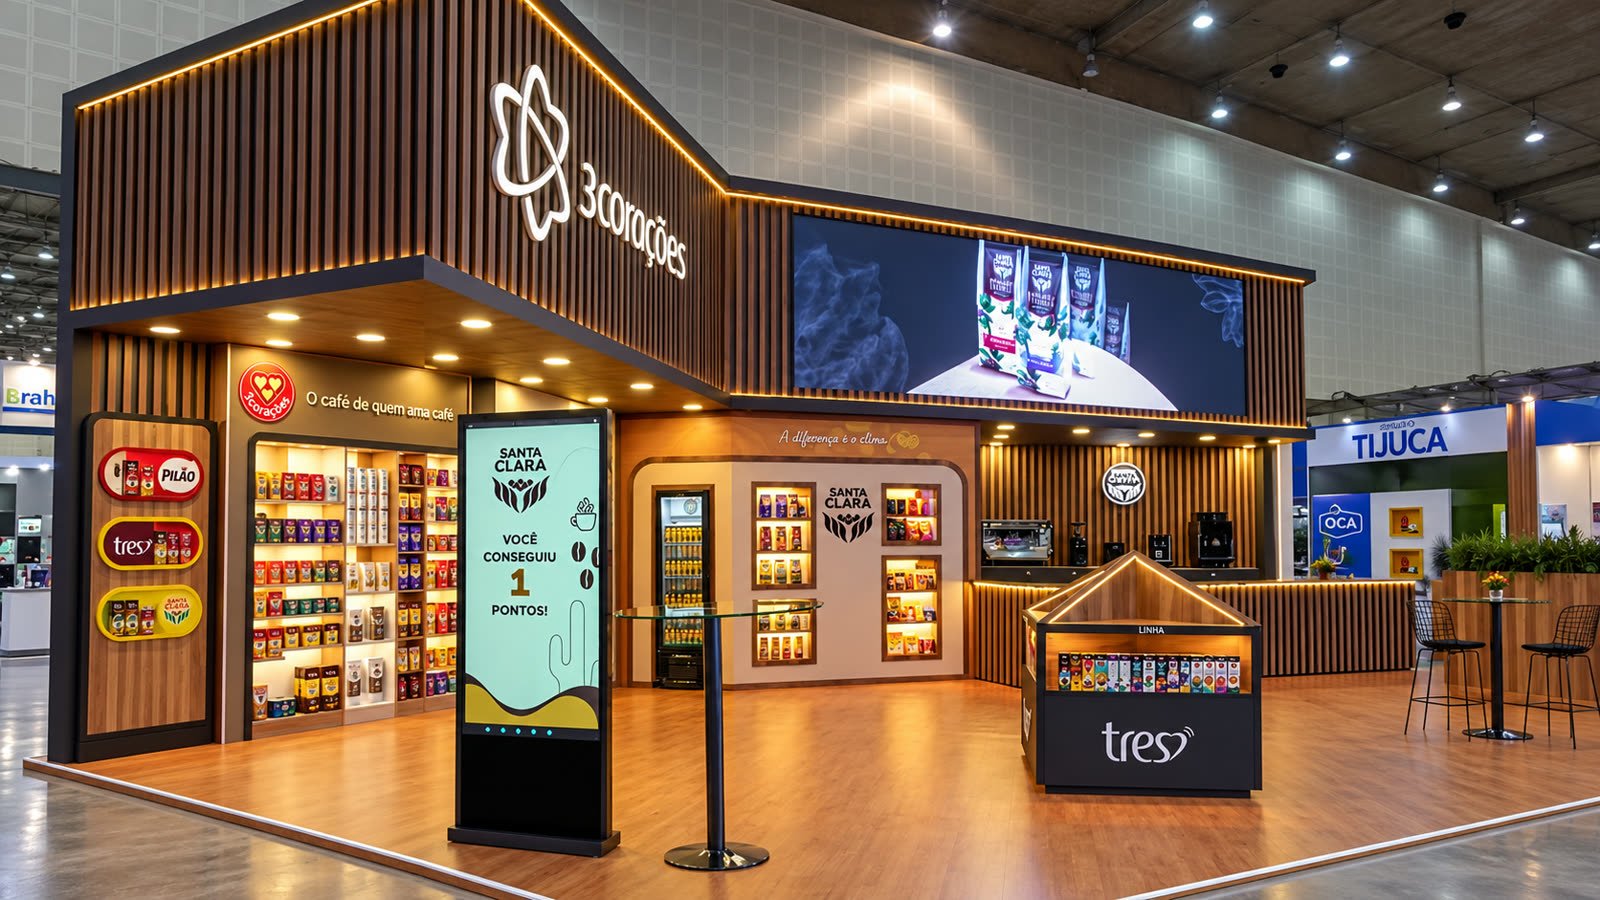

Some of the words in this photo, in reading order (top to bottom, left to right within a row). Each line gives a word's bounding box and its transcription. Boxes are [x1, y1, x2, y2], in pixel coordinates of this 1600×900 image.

[577, 162, 686, 280] 3corações
[244, 391, 290, 419] 3corações
[306, 391, 318, 406] O
[320, 394, 350, 409] café
[352, 396, 369, 411] de
[372, 401, 405, 416] quem
[407, 406, 430, 419] ama
[432, 408, 454, 422] café
[779, 430, 789, 443] A
[1352, 426, 1448, 459] TIJUCA
[500, 447, 542, 459] SANTA
[495, 459, 547, 472] CLARA
[161, 467, 196, 482] PILÃO
[829, 487, 867, 497] SANTA
[824, 497, 871, 509] CLARA
[1325, 517, 1357, 529] OCA
[502, 531, 538, 545] VOCÊ
[113, 536, 153, 555] tres
[483, 552, 556, 562] CONSEGUIU
[511, 568, 530, 597] 1
[492, 605, 548, 616] PONTOS!
[1139, 626, 1164, 634] LINHA
[1101, 721, 1188, 763] tres
